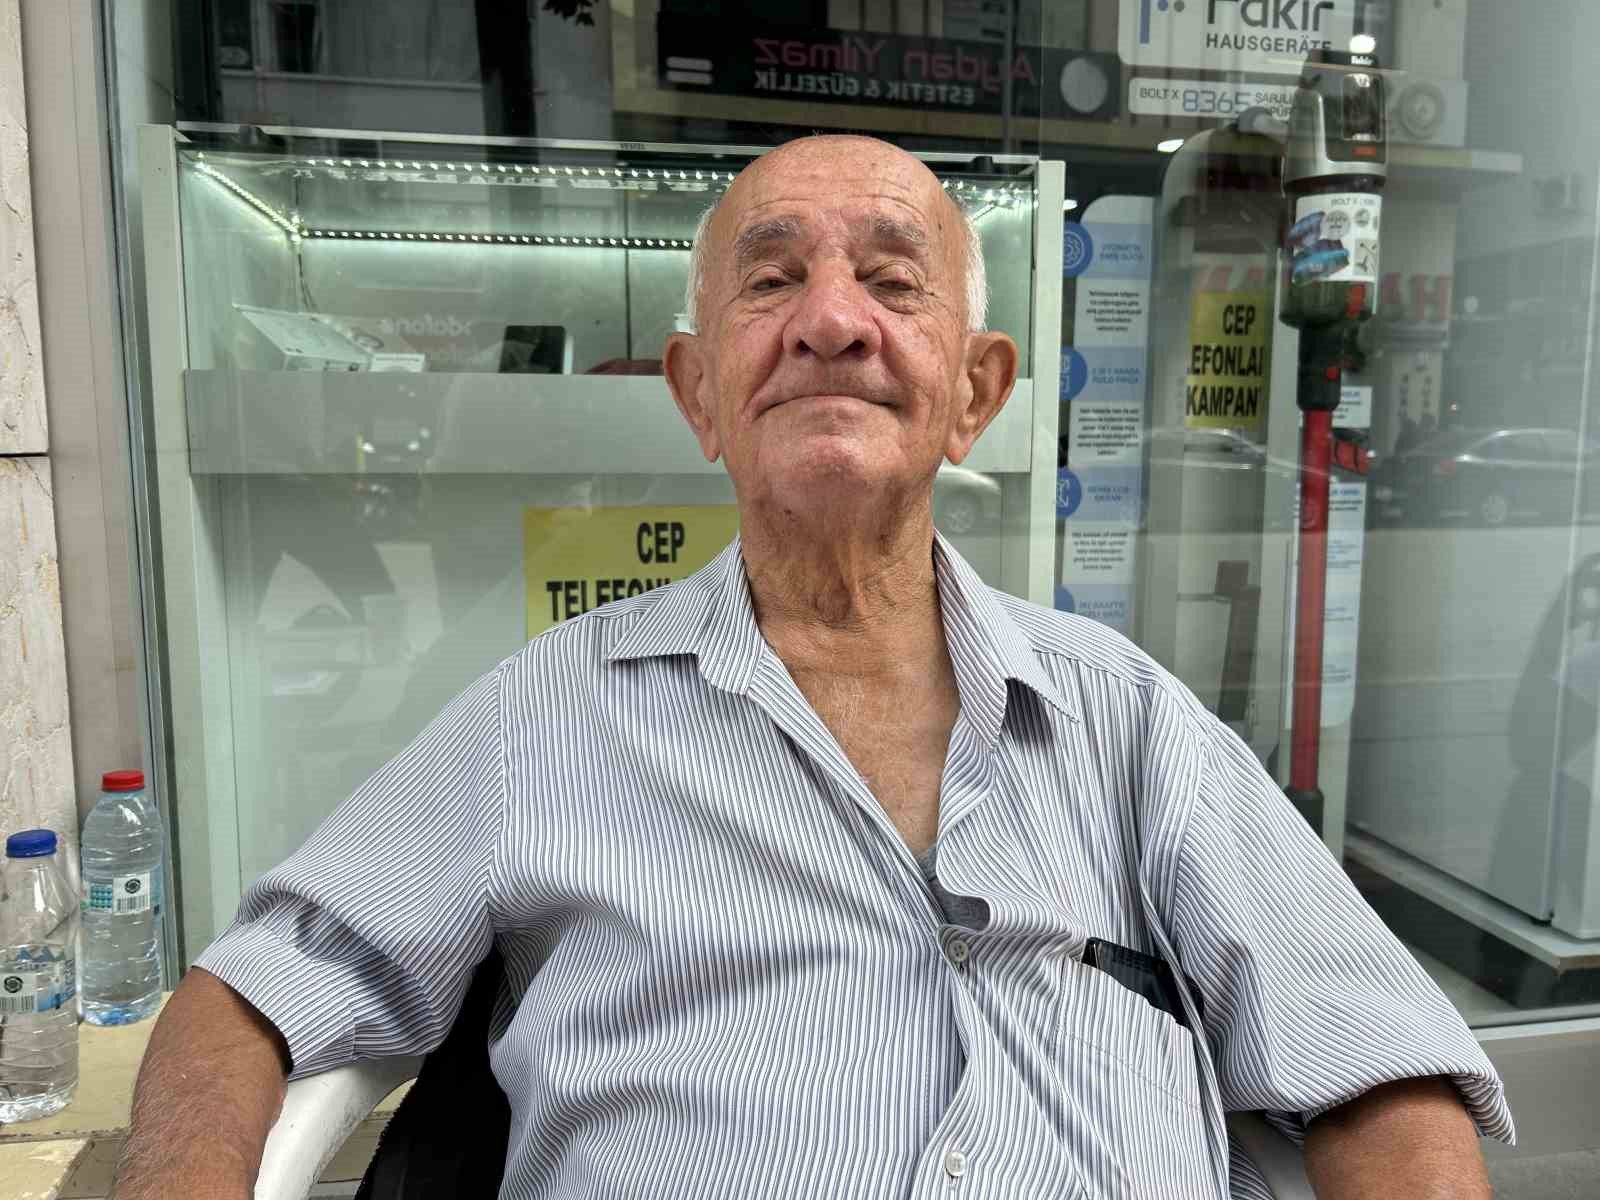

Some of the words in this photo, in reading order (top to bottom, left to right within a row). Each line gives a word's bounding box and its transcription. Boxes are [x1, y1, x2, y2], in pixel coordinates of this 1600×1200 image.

[1206, 33, 1332, 53] HAUSGERÄTE
[1140, 87, 1169, 100] BOLT
[1171, 89, 1181, 100] X
[1182, 89, 1252, 113] 8365
[1223, 304, 1255, 336] CEP
[1187, 344, 1264, 376] EFONLA
[1186, 384, 1260, 417] KAMPAN
[637, 521, 685, 564] CEP
